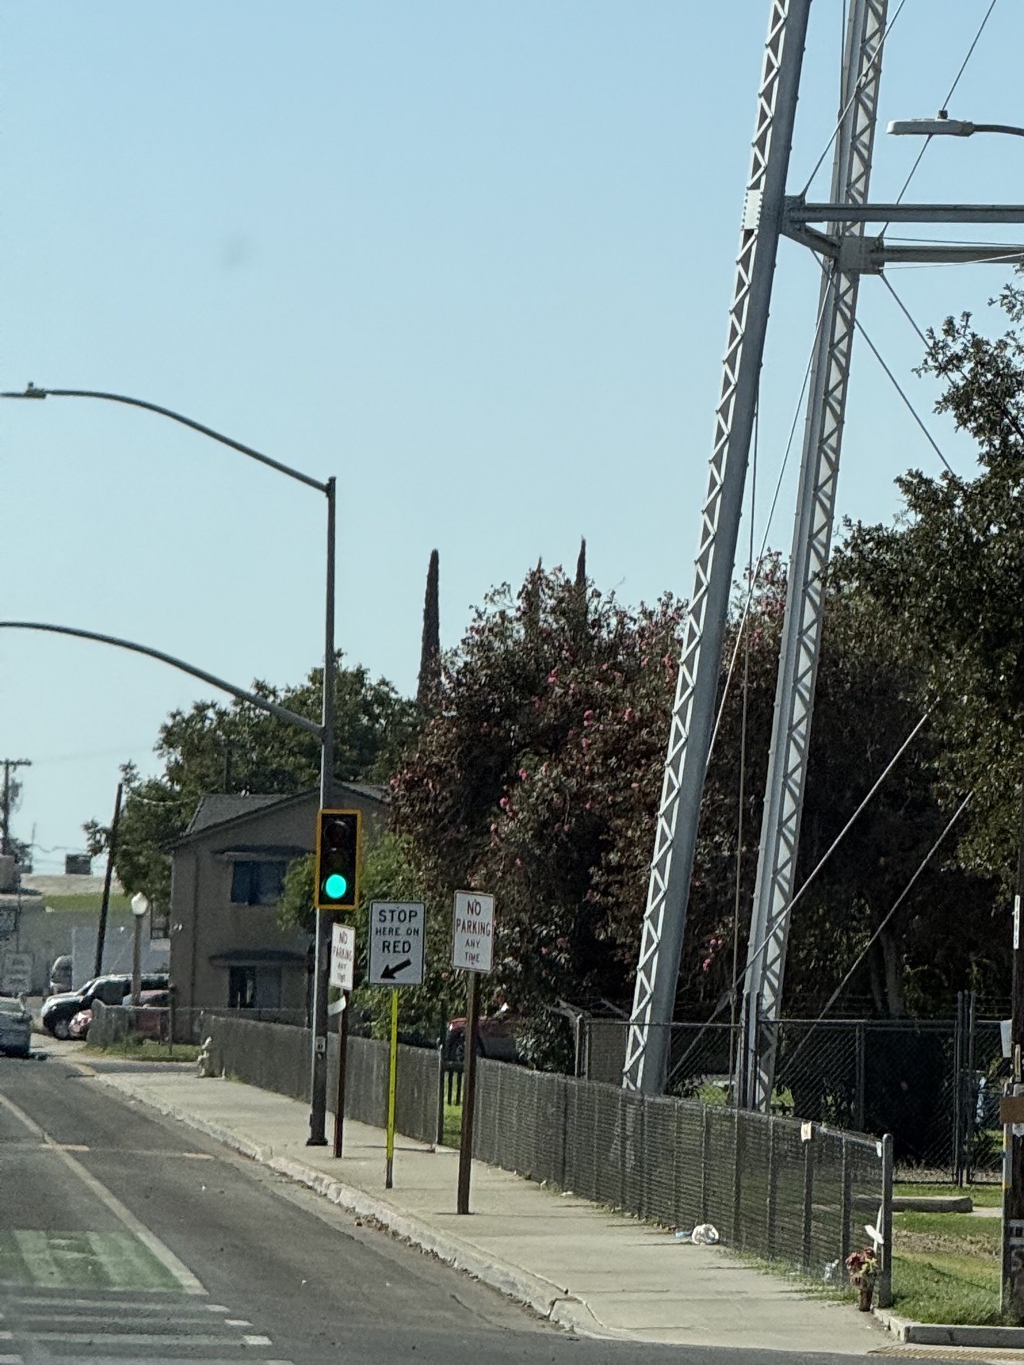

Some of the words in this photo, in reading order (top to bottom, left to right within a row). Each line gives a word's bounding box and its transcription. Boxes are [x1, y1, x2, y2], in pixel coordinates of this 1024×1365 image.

[467, 900, 481, 916] NO
[378, 909, 418, 923] STOP
[375, 927, 401, 936] HERE
[406, 927, 419, 937] ON
[456, 919, 491, 937] PARKING
[338, 931, 348, 945] NO
[465, 938, 481, 949] ANY
[333, 946, 353, 962] PARKING
[382, 940, 411, 954] RED
[464, 951, 480, 963] TIME
